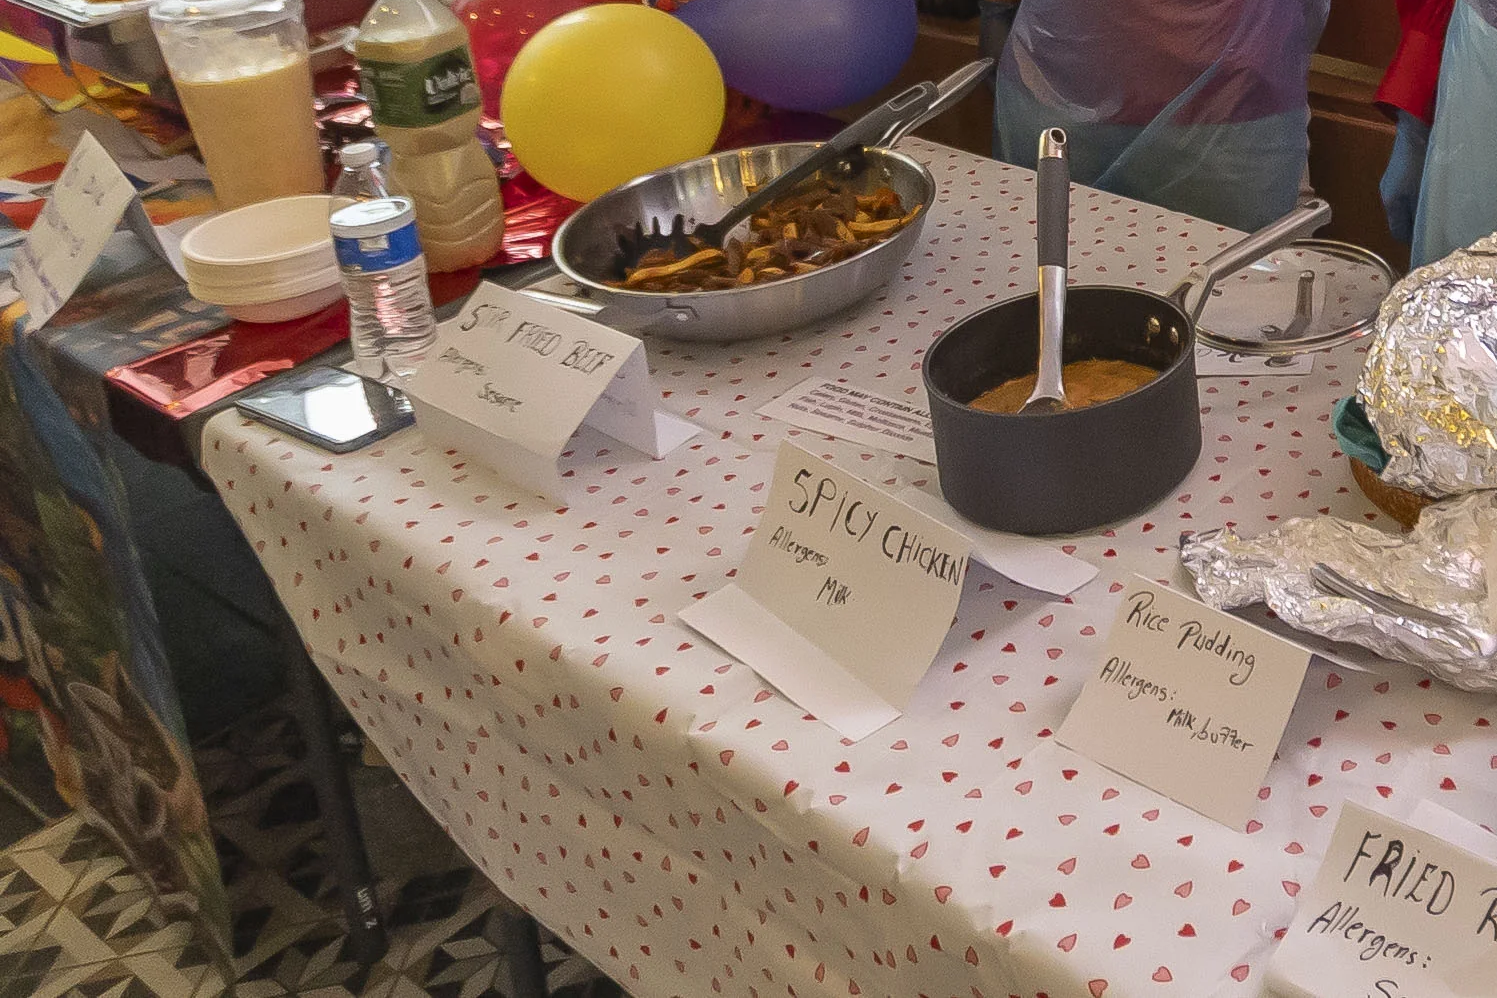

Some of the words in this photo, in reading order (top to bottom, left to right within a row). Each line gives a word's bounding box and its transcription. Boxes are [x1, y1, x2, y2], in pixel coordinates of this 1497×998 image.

[820, 383, 849, 394] FOOD
[848, 391, 872, 399] MAY
[869, 398, 913, 413] CONTAIN
[789, 469, 879, 542] SPICY
[1127, 591, 1170, 632] Rice
[1177, 621, 1256, 686] Pudding
[1100, 656, 1177, 701] Allergens:
[1307, 901, 1431, 968] Allergens:
